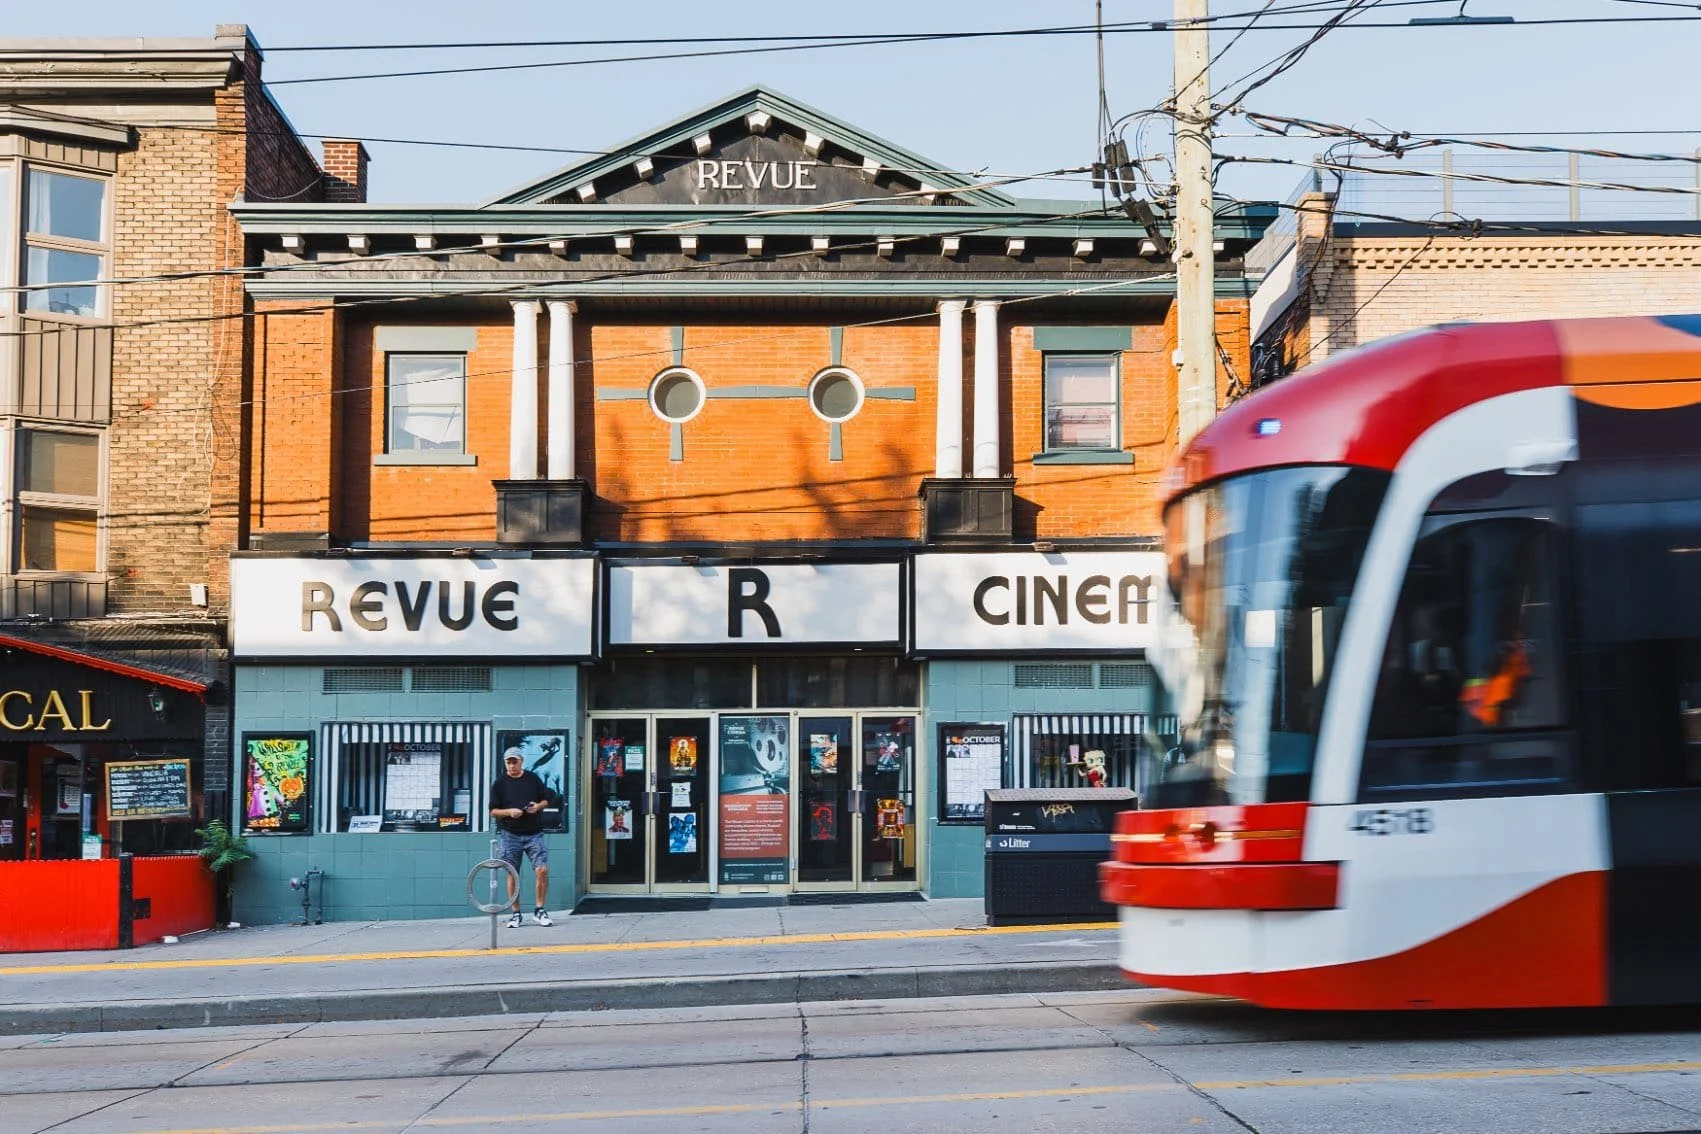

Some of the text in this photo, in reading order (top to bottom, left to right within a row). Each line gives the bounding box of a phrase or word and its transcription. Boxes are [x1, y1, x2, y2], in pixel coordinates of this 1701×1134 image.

[698, 159, 817, 190] REVUE
[301, 580, 520, 632] REVUE
[727, 567, 782, 638] R
[0, 689, 112, 731] CAL
[963, 736, 1001, 744] OCTOBER
[1008, 837, 1031, 848] Litter
